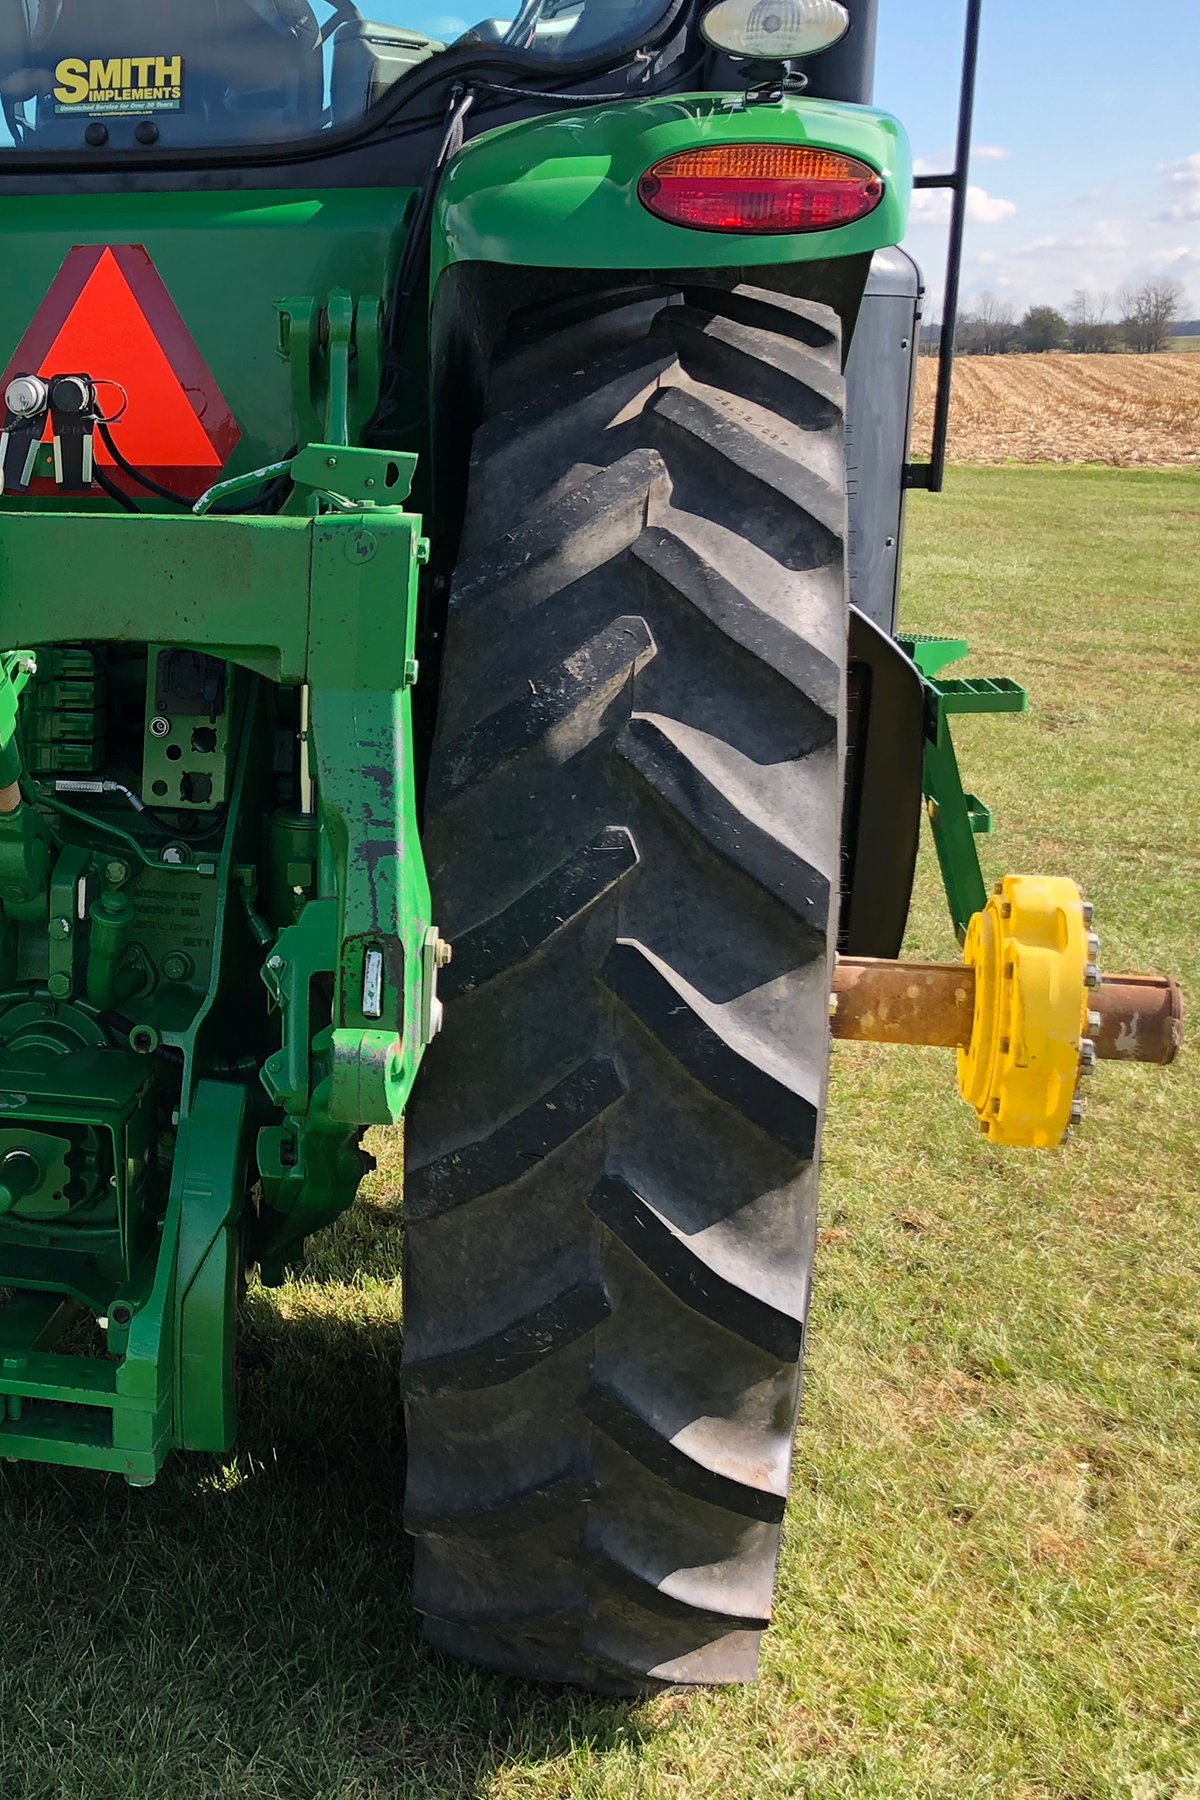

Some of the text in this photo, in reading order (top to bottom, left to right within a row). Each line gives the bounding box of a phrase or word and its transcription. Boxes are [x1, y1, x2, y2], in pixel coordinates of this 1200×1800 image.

[53, 55, 181, 104] SMITH
[88, 87, 181, 102] IMPLEMENTS
[59, 104, 95, 113] Unmatched
[95, 103, 119, 111] Service
[119, 102, 131, 110] for
[156, 101, 174, 109] Years
